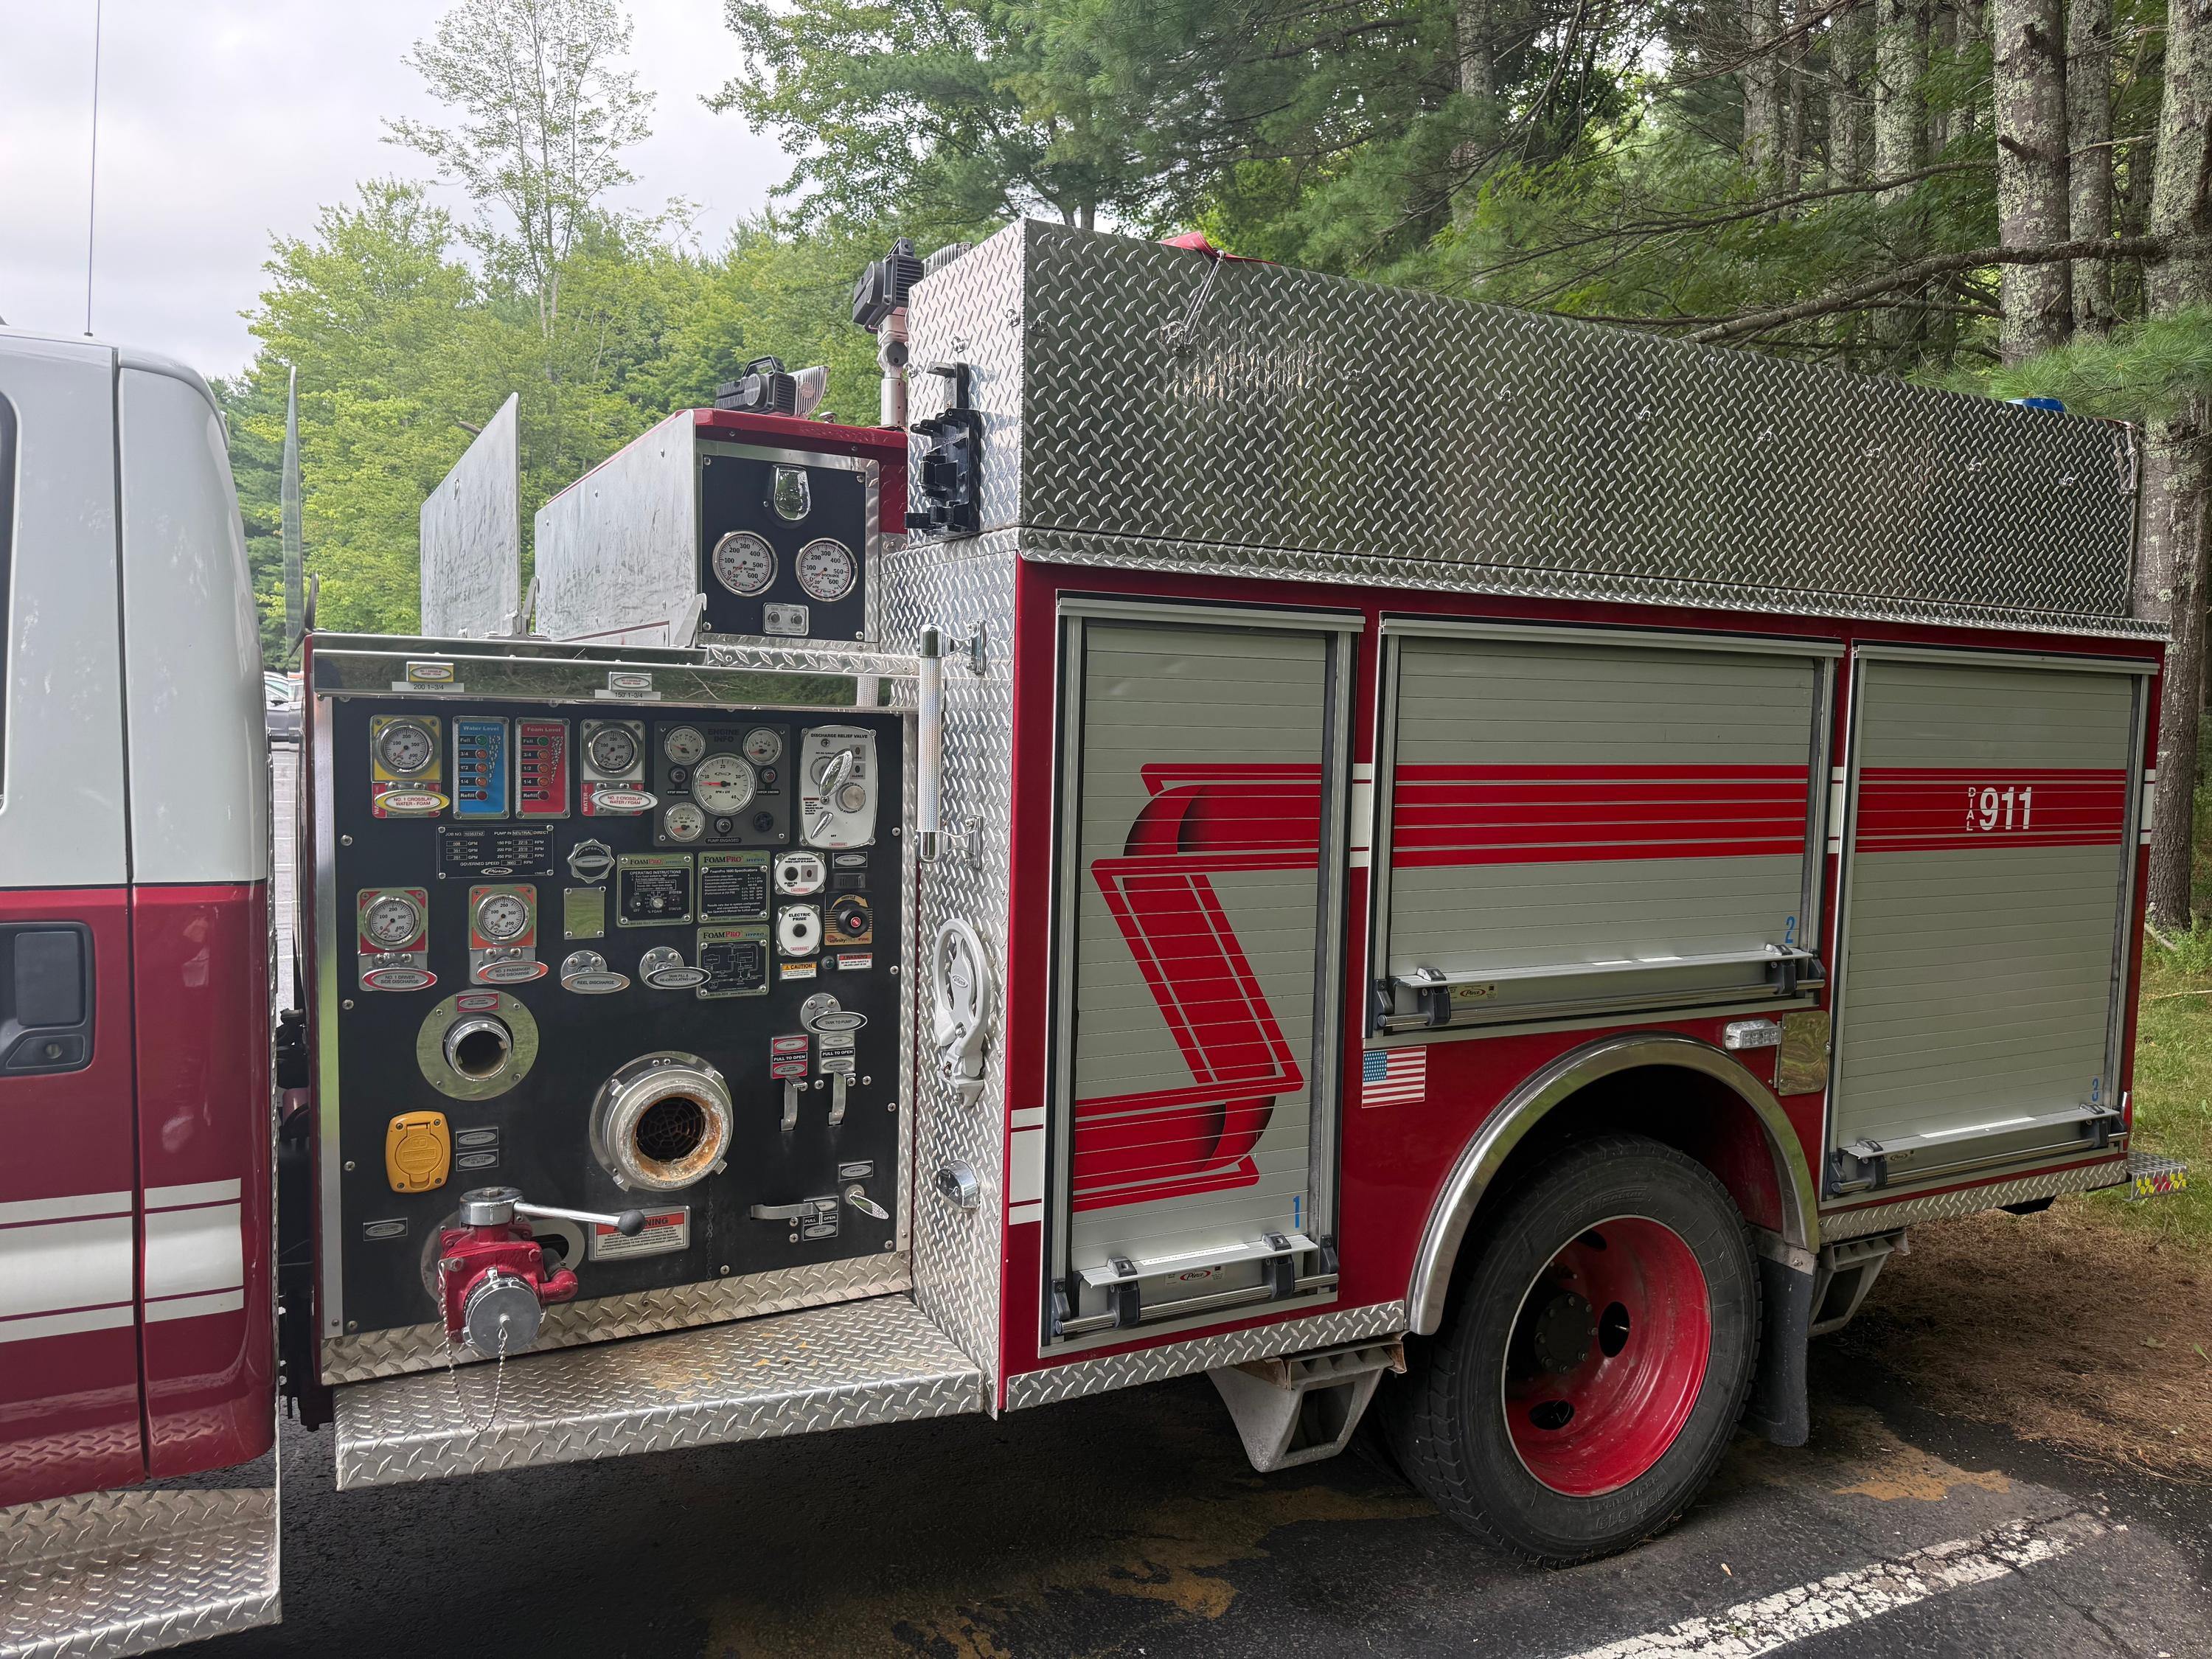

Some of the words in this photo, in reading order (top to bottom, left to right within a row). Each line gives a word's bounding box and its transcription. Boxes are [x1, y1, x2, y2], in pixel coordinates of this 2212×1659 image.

[1966, 787, 1977, 831] DIAL
[1979, 786, 2032, 831] 911
[1785, 916, 1795, 944] 2
[2092, 1078, 2098, 1102] 3
[645, 1217, 669, 1227] NING
[1293, 1195, 1300, 1228] 1
